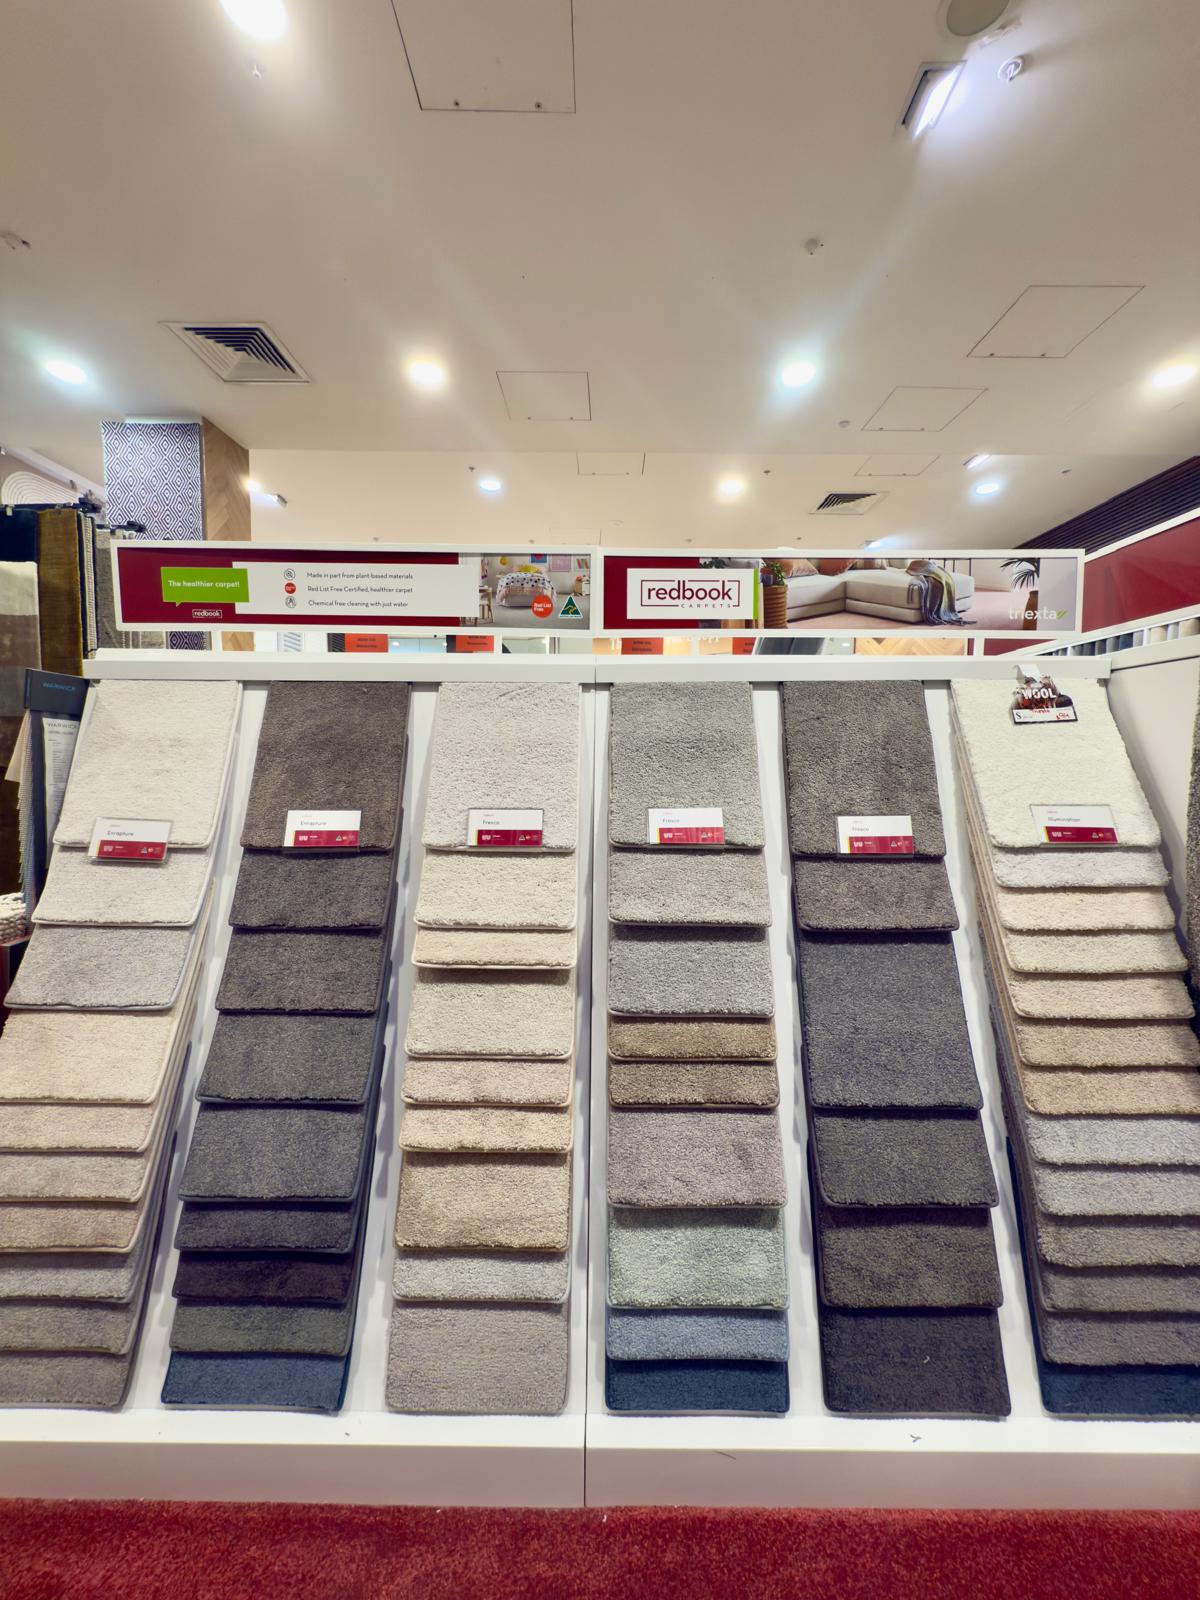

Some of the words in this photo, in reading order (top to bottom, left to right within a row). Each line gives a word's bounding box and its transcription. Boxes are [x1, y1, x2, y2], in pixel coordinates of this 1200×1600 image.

[215, 581, 240, 589] carpet!
[647, 580, 733, 601] redbook
[346, 600, 369, 608] cleaning
[1008, 607, 1057, 620] triexta
[1021, 687, 1056, 699] WOOL
